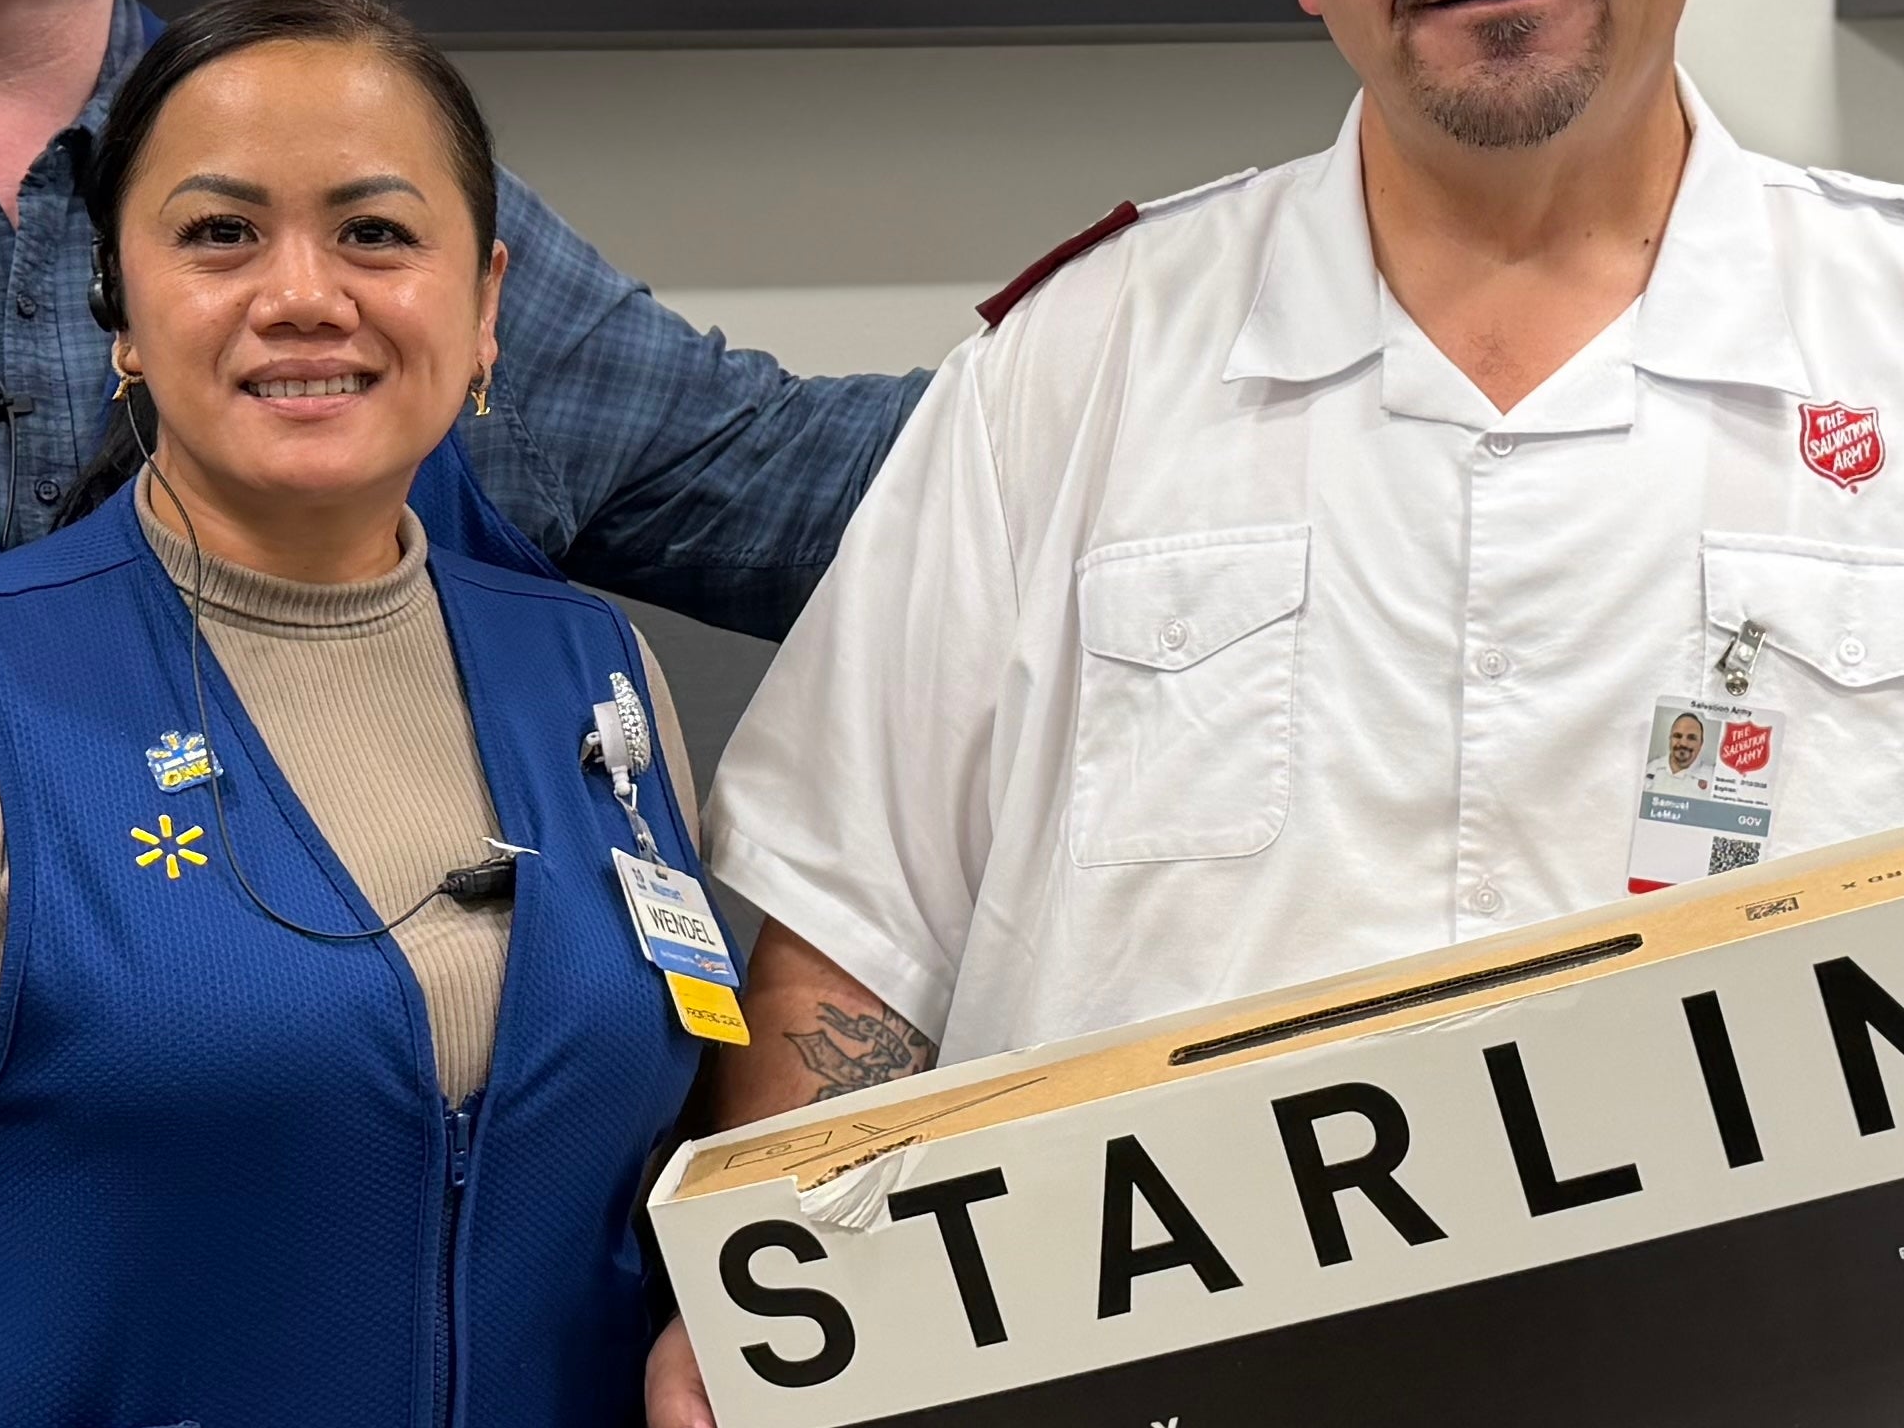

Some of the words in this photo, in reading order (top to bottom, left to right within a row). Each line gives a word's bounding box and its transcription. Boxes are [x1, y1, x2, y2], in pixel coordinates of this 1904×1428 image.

[1816, 410, 1848, 433] THE
[1809, 415, 1873, 459] SALVATION
[1833, 436, 1872, 472] ARMY
[1690, 700, 1730, 713] Salvation
[1731, 706, 1752, 717] Army
[1722, 732, 1766, 758] SALVATION
[1732, 726, 1751, 741] THE
[1735, 745, 1764, 767] ARMY
[162, 758, 212, 787] ONE
[1652, 796, 1690, 811] Samuel
[1841, 880, 1857, 890] X
[647, 904, 716, 947] WENDEL
